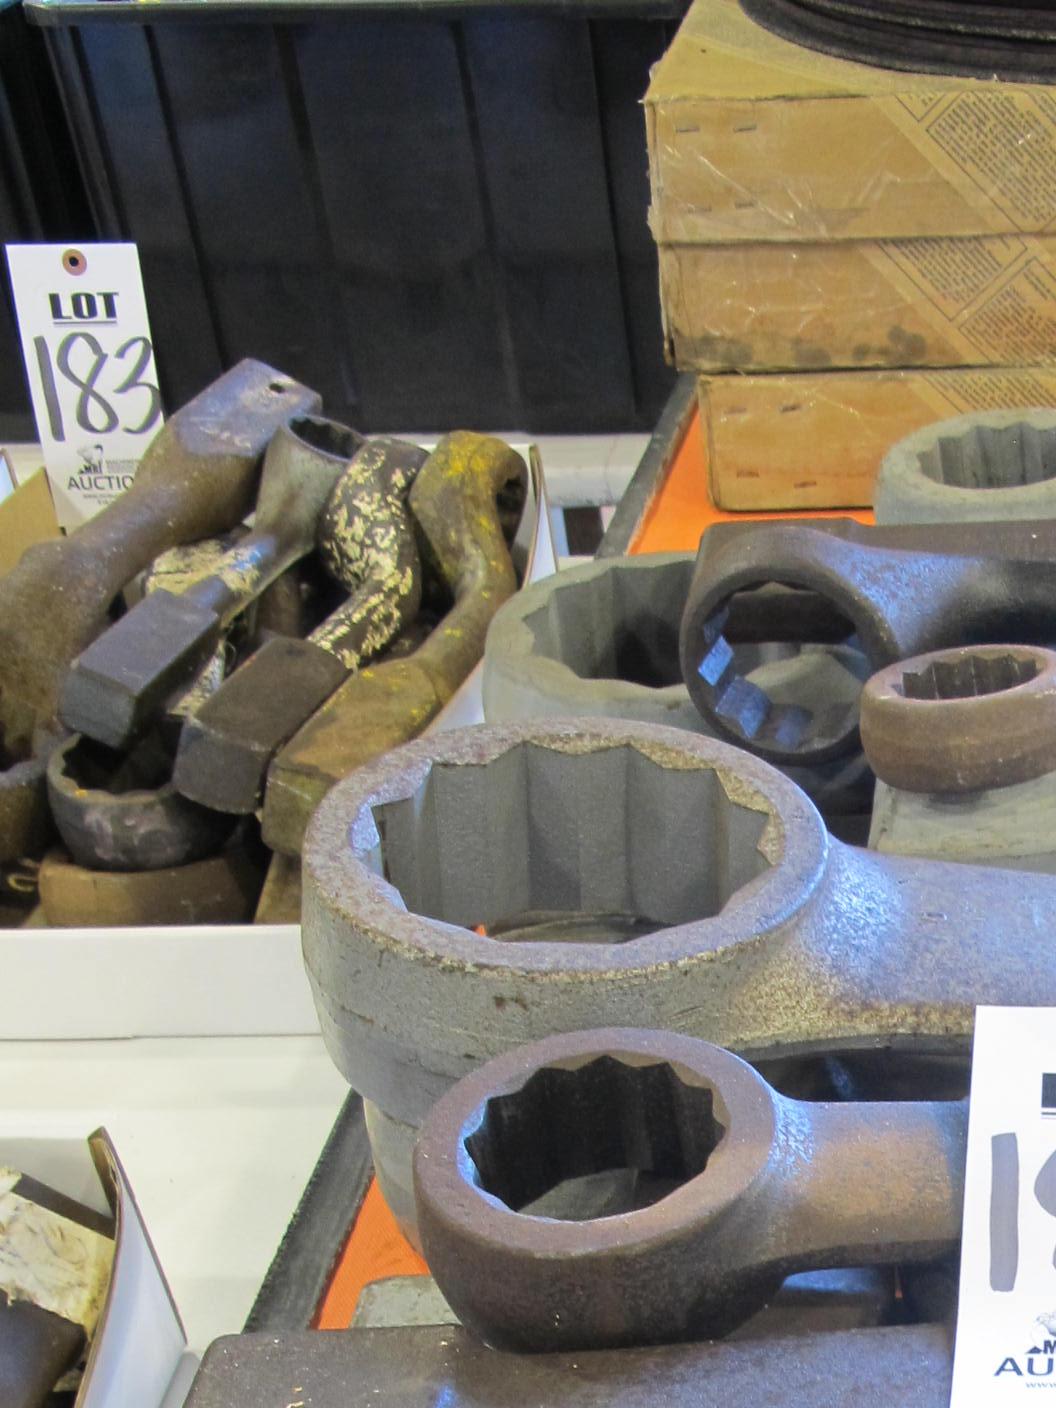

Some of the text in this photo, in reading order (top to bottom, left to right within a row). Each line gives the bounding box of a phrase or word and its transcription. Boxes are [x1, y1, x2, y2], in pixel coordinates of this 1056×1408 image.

[48, 292, 119, 320] LOT
[33, 332, 161, 442] 183
[67, 475, 134, 490] AUCTIO
